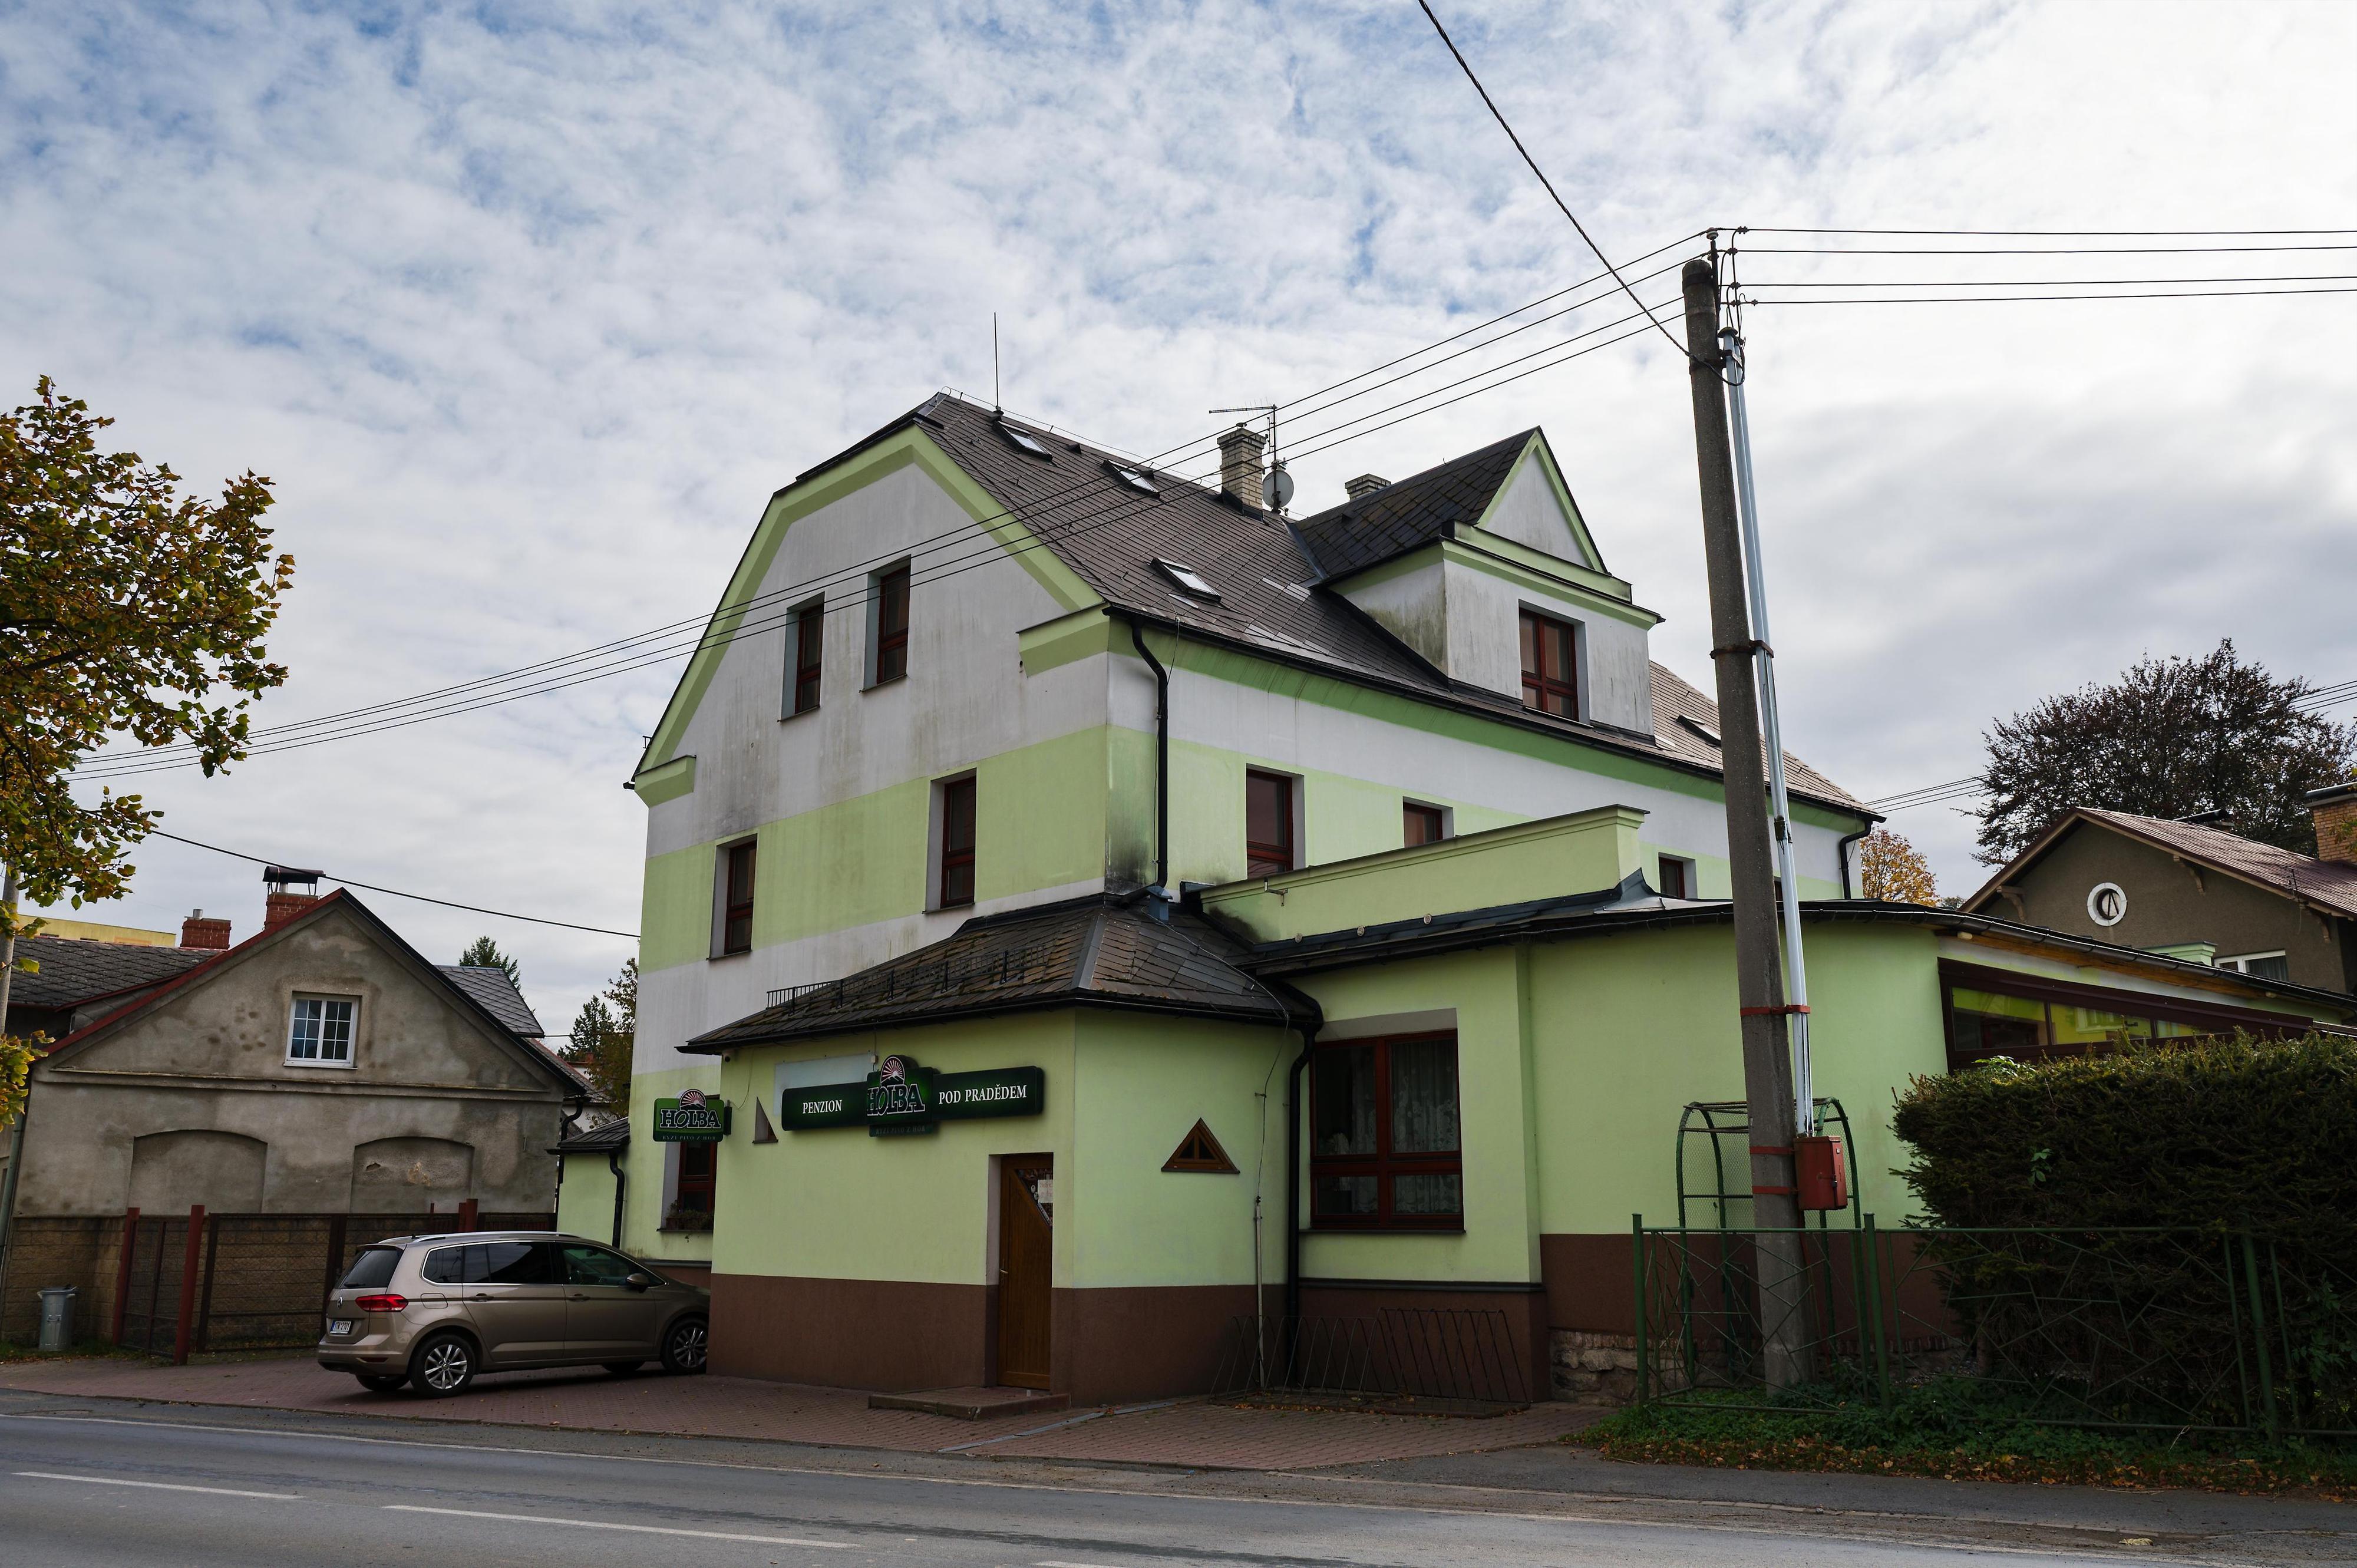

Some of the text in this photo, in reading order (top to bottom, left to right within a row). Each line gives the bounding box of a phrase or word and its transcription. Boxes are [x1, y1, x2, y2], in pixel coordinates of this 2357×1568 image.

[867, 1084, 925, 1116] HOLBA
[939, 1084, 1027, 1105] POD PRADĚDEM
[803, 1100, 843, 1114] PENZION
[660, 1109, 721, 1128] HOLBA
